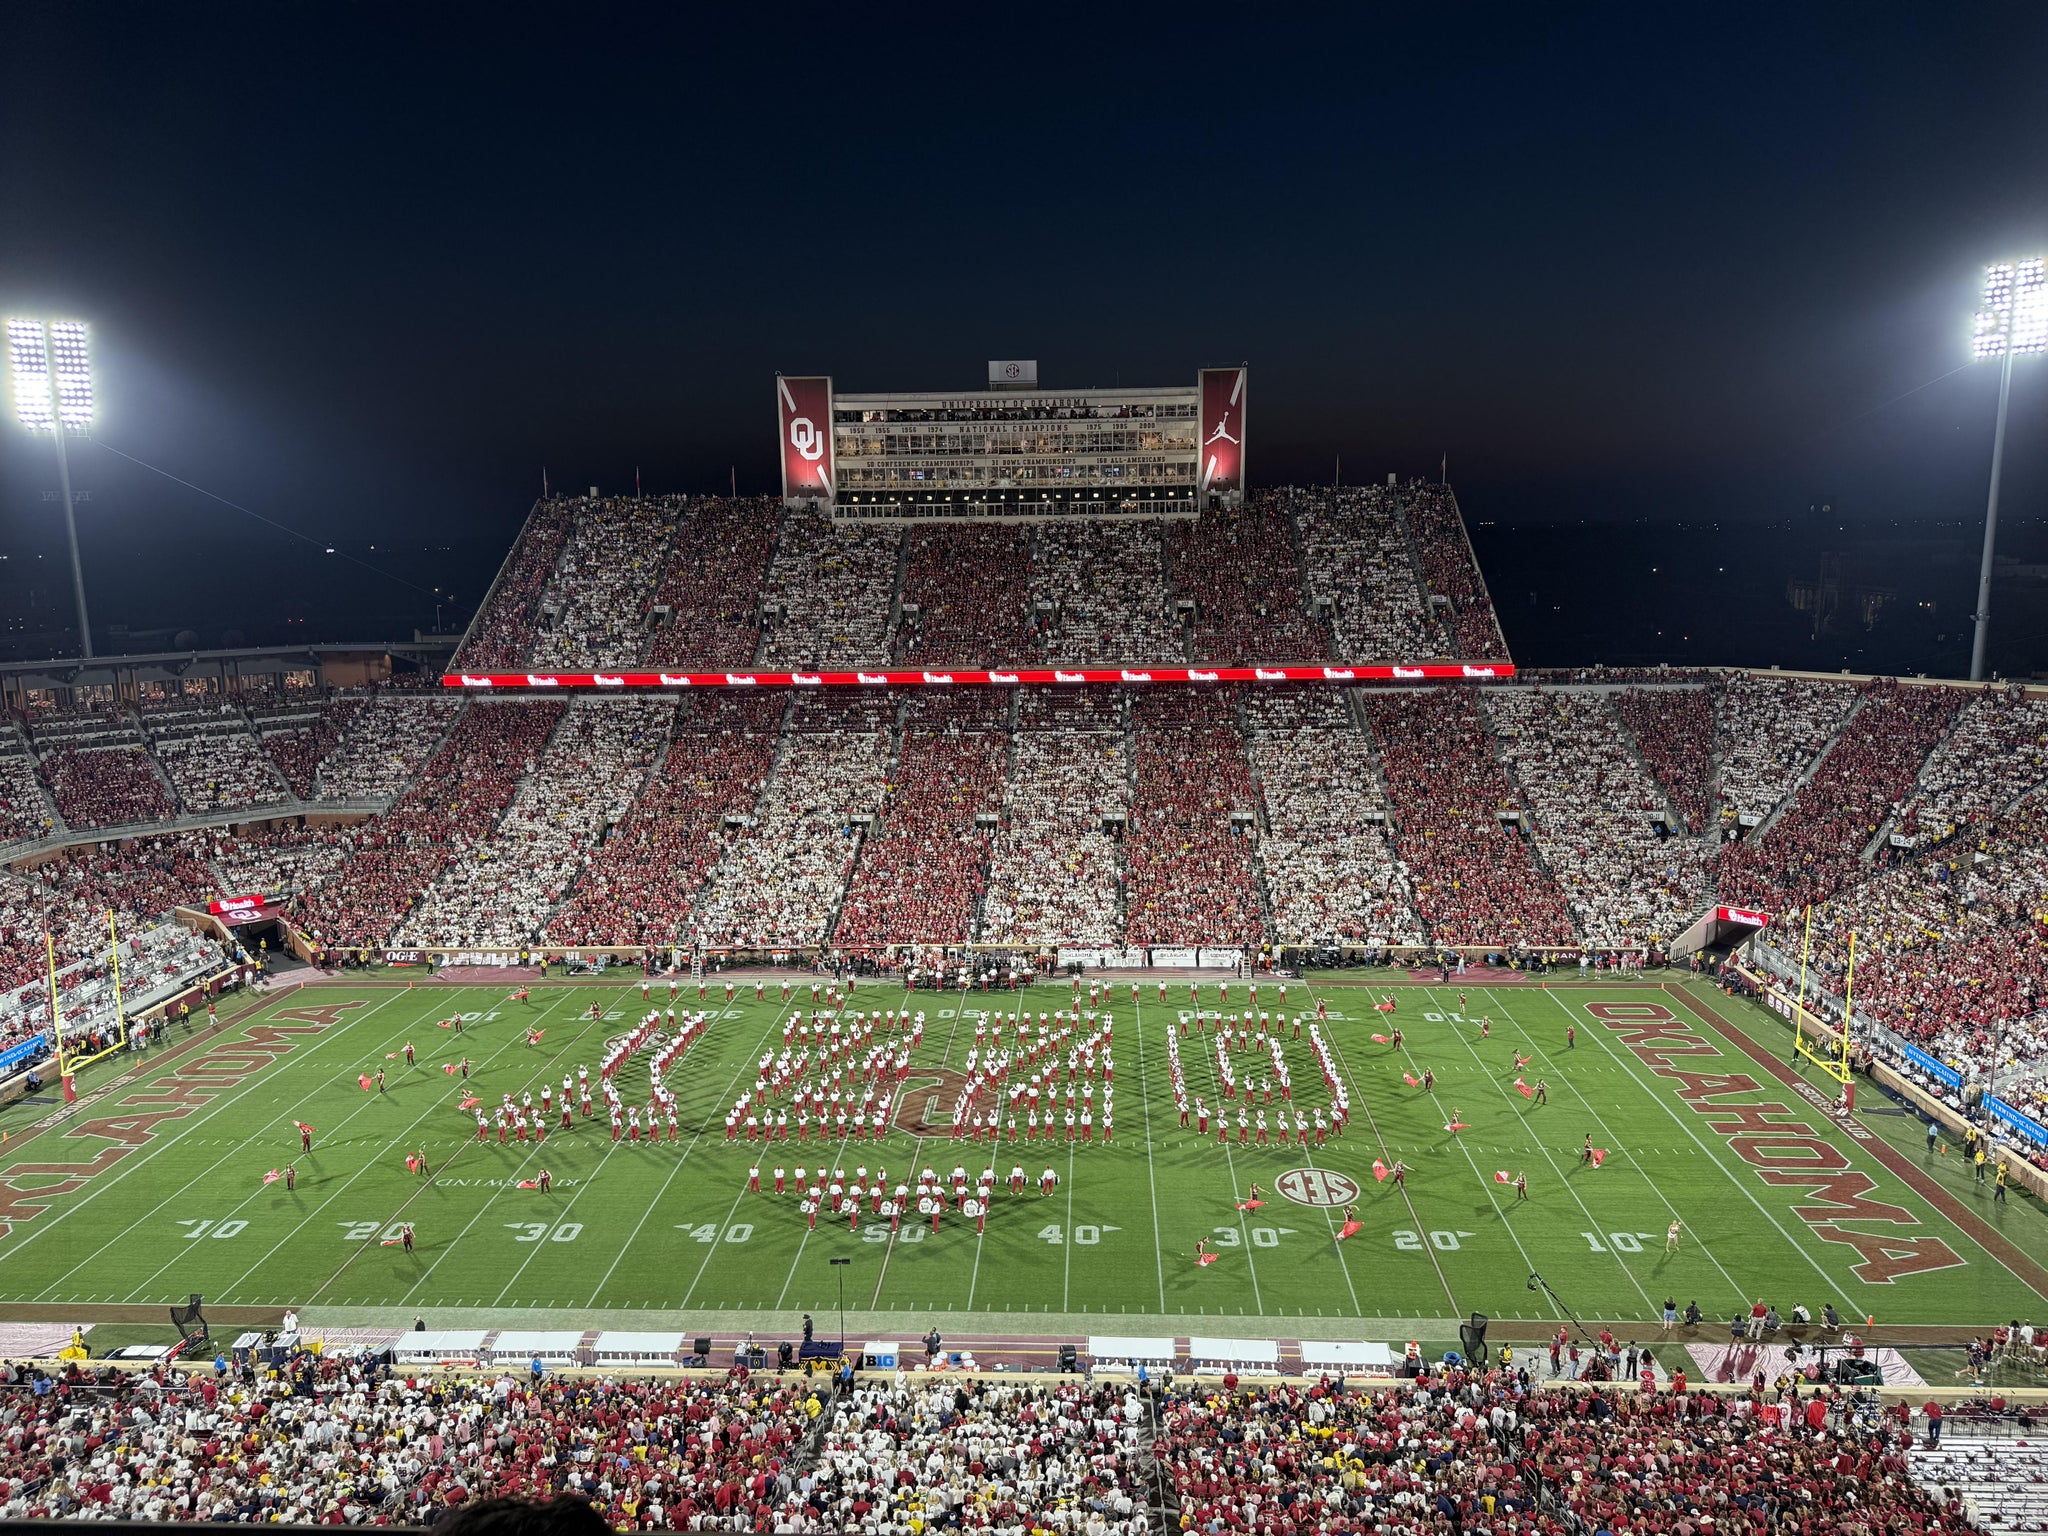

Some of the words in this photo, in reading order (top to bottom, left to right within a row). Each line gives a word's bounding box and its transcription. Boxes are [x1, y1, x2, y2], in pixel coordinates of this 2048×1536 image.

[941, 400, 1007, 409] UNIVERSITY
[1031, 398, 1088, 407] OKLAHOMA
[959, 425, 1007, 433] NATIONAL
[1012, 423, 1069, 432] CHAMPIONS
[790, 417, 823, 460] OU
[1110, 456, 1166, 464] ALL-AMERICANS
[1129, 672, 1151, 681] Health
[1196, 671, 1218, 680] Health
[1264, 670, 1286, 679] Health
[1332, 669, 1354, 678] Health
[1401, 668, 1424, 677] Health
[1471, 668, 1494, 676] Health
[470, 678, 492, 686] Health
[535, 677, 558, 686] Health
[602, 677, 624, 685] Health
[668, 676, 690, 685] Health
[734, 676, 756, 684] Health
[800, 675, 822, 684] Health
[866, 675, 887, 683] Health
[931, 674, 953, 683] Health
[997, 674, 1019, 682] Health
[1063, 673, 1085, 682] Health
[1894, 836, 1912, 846] 13-14
[229, 899, 255, 910] Health
[1737, 913, 1763, 927] Health
[1986, 1097, 2017, 1121] RVERWIND
[0, 1001, 370, 1238] KLAHOMA
[1836, 1118, 1873, 1139] CLUB
[1584, 1001, 1968, 1284] OKLAHOMA
[1282, 1171, 1354, 1204] SEC
[183, 1219, 250, 1239] 10
[343, 1221, 416, 1240] 20
[514, 1222, 584, 1242] 30
[688, 1223, 755, 1243] 40
[861, 1223, 927, 1243] 50
[1037, 1224, 1100, 1245] 40
[1213, 1226, 1280, 1247] 30
[1391, 1230, 1461, 1250] 20
[1580, 1232, 1644, 1252] 10
[810, 1360, 827, 1371] M
